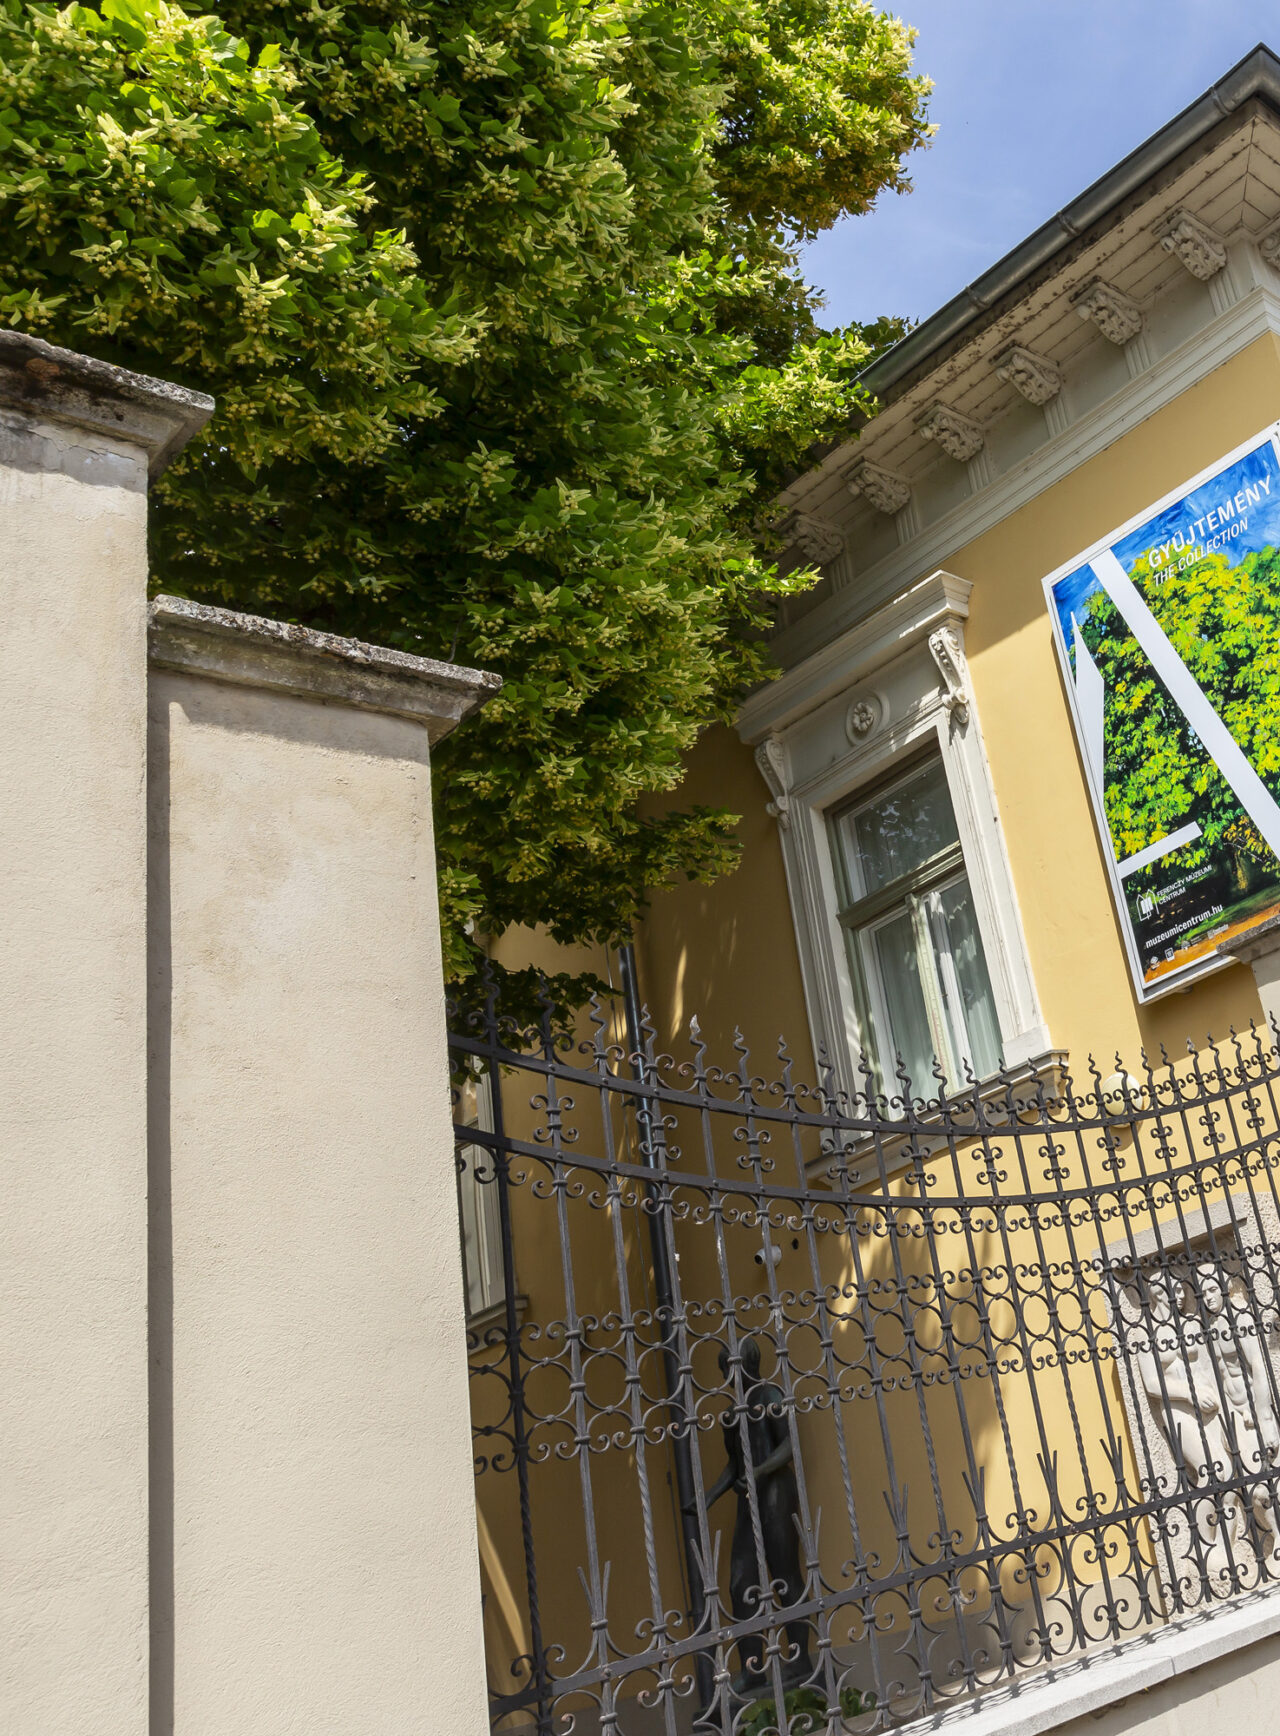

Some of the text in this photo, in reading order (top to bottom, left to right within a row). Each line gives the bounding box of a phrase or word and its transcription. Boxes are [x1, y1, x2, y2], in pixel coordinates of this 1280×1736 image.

[1148, 475, 1271, 568] GYŰJTEMÉNY
[1153, 517, 1248, 587] THE COLLECTION
[1156, 878, 1185, 897] FERENCZY
[1158, 887, 1186, 905] CENTRUM
[1145, 904, 1224, 949] muzeumicentrum.hu
